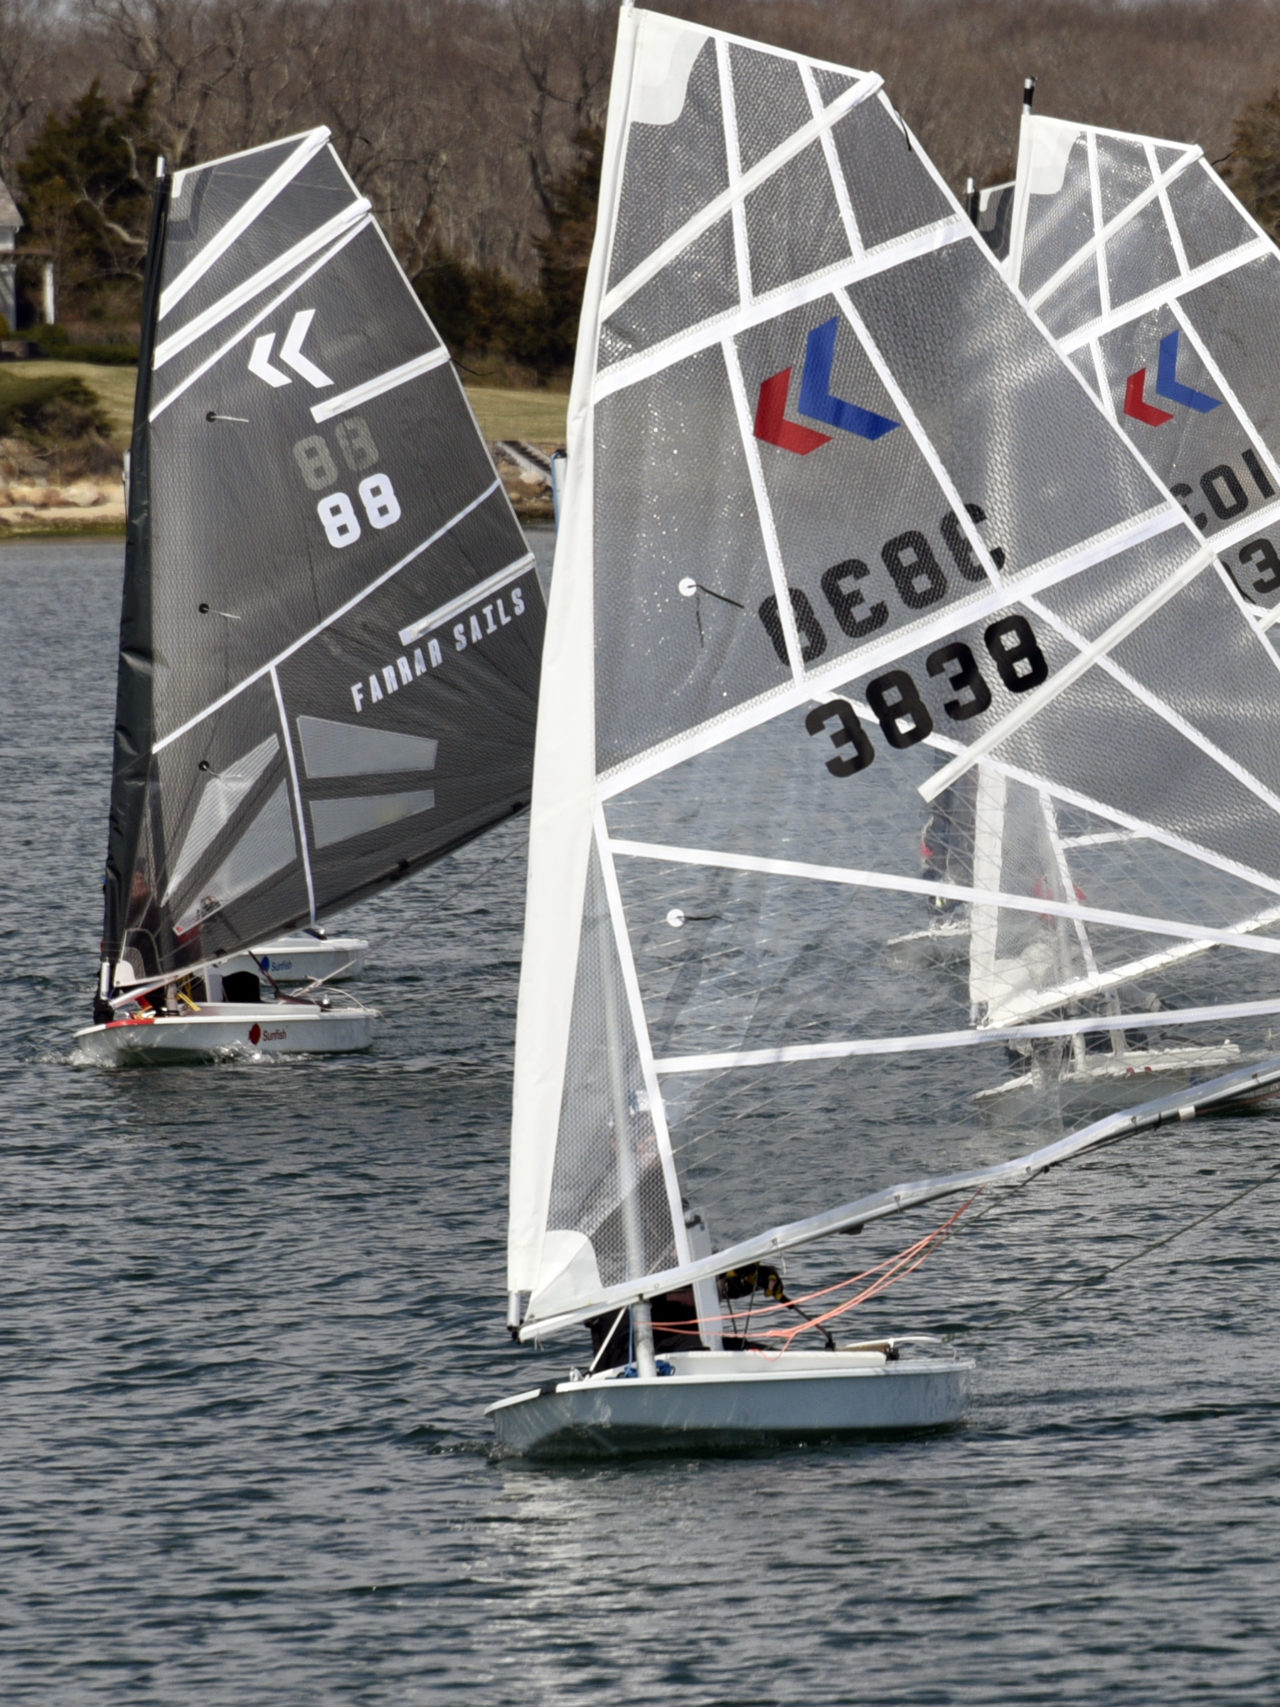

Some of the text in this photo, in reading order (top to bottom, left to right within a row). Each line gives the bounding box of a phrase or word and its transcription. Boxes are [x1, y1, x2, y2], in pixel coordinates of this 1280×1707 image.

[317, 473, 401, 548] 88
[351, 588, 526, 713] FARRAR SAILS
[805, 614, 1048, 777] 3838
